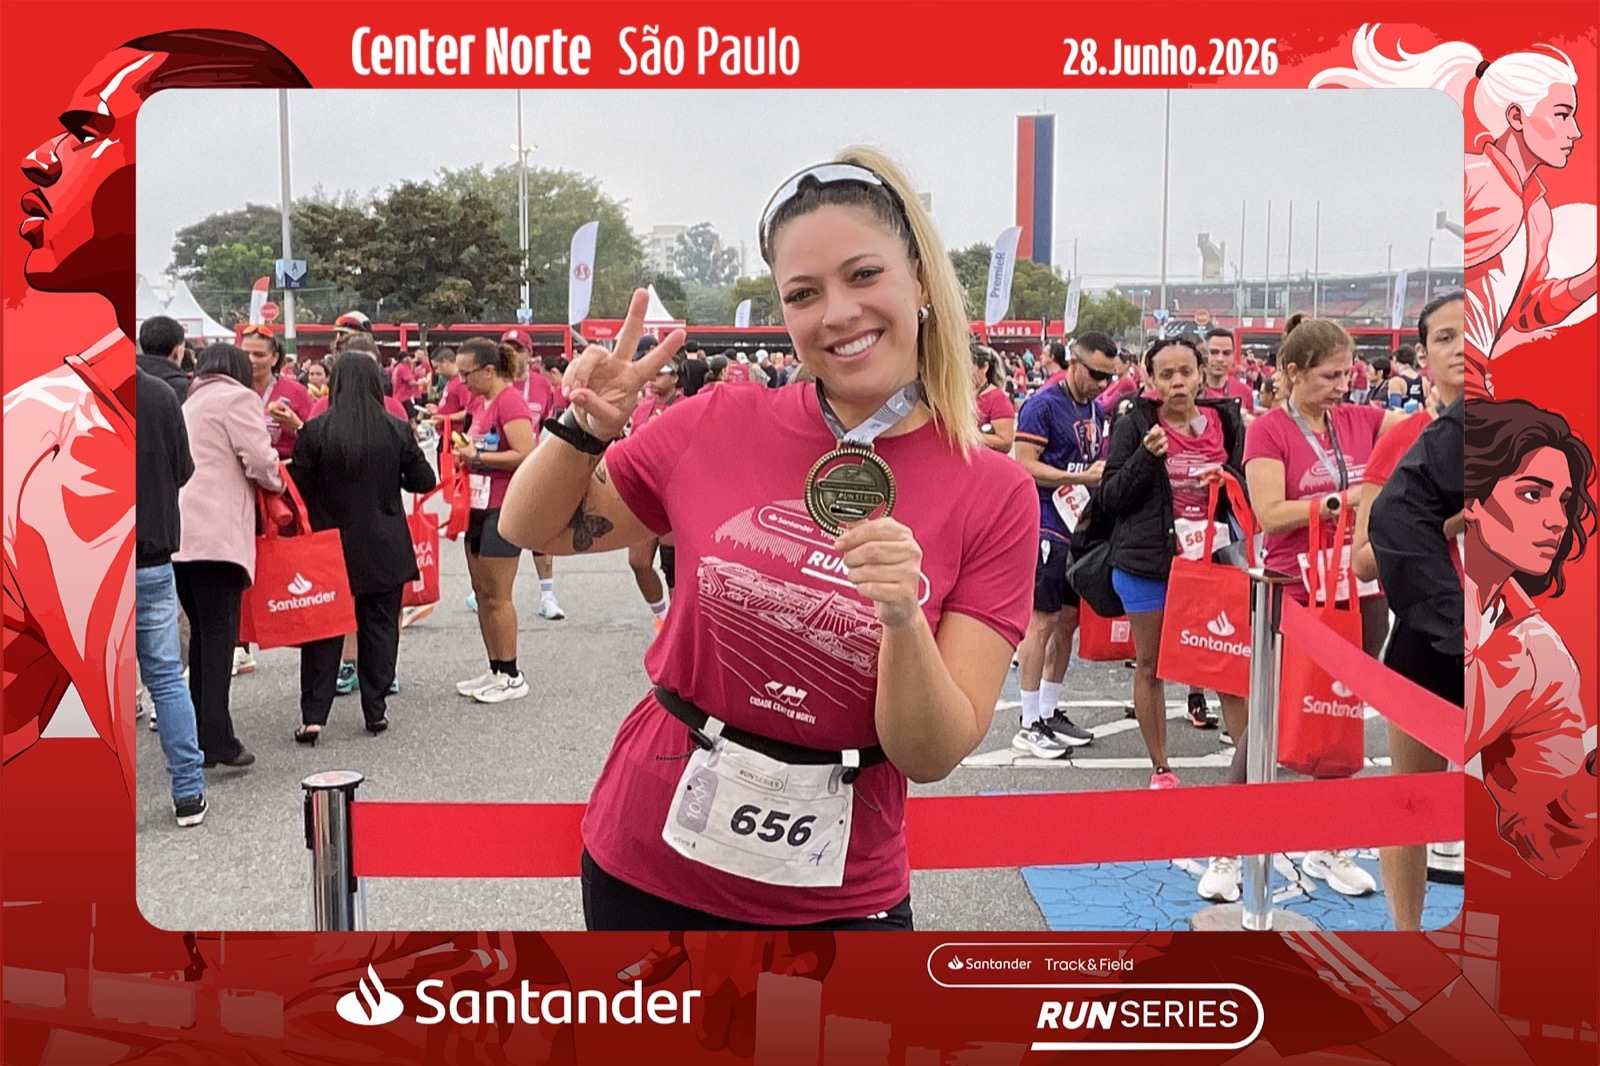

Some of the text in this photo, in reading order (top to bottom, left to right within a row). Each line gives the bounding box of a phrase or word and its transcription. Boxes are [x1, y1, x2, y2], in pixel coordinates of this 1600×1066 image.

[778, 516, 814, 533] Santander
[1185, 528, 1210, 547] 58
[267, 590, 336, 613] Santander
[1180, 630, 1252, 657] Santande
[750, 696, 816, 725] CIDADE CENTER NORTE
[1302, 695, 1364, 719] Santand
[686, 777, 709, 819] 10KM
[730, 804, 817, 847] 656
